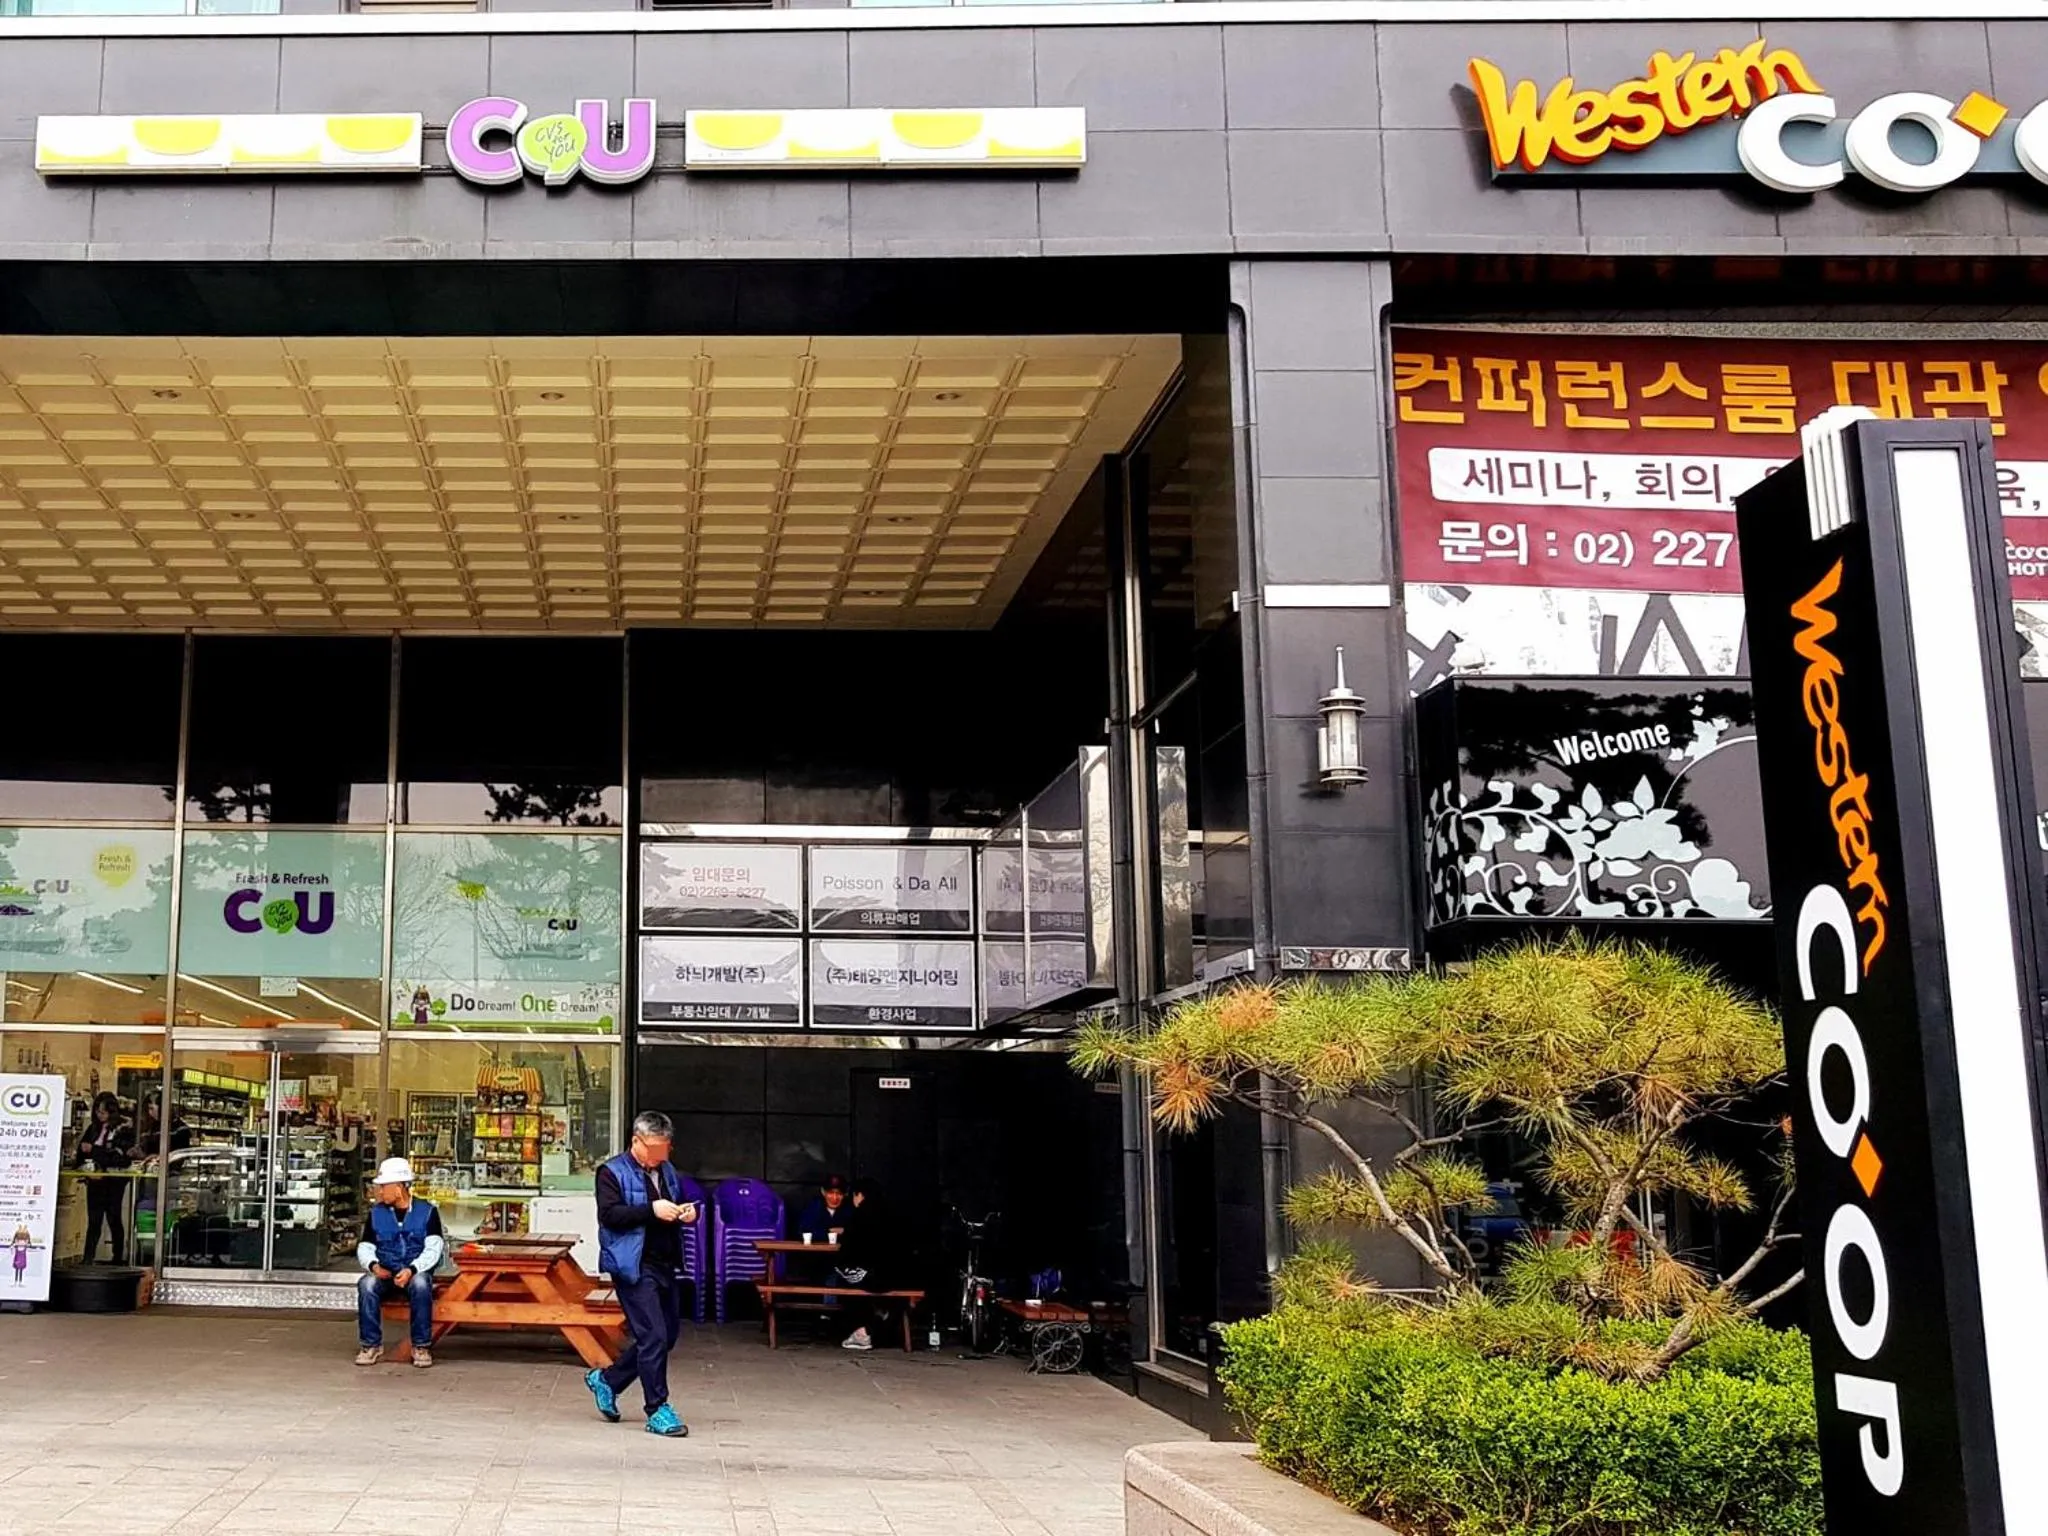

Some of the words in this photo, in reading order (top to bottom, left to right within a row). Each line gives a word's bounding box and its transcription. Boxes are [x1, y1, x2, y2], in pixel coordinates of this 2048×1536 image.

[1467, 38, 1824, 172] Western
[446, 97, 657, 185] CU
[1393, 352, 1797, 434] 컨퍼런스룸
[1463, 457, 1611, 502] 세미나,
[1438, 520, 1529, 566] 문의
[1573, 530, 1635, 568] 02)
[1554, 723, 1671, 766] Welcome
[1790, 556, 1888, 977] Western
[235, 873, 268, 884] Fresh
[271, 873, 281, 884] &
[283, 872, 330, 885] Refresh
[822, 875, 884, 891] Poisson
[892, 877, 902, 891] &
[908, 876, 931, 891] Da
[938, 876, 957, 891] All
[223, 888, 336, 935] CU
[451, 993, 475, 1012] Do
[520, 994, 557, 1013] One
[10, 1092, 41, 1108] CU
[20, 1127, 48, 1139] OPEN
